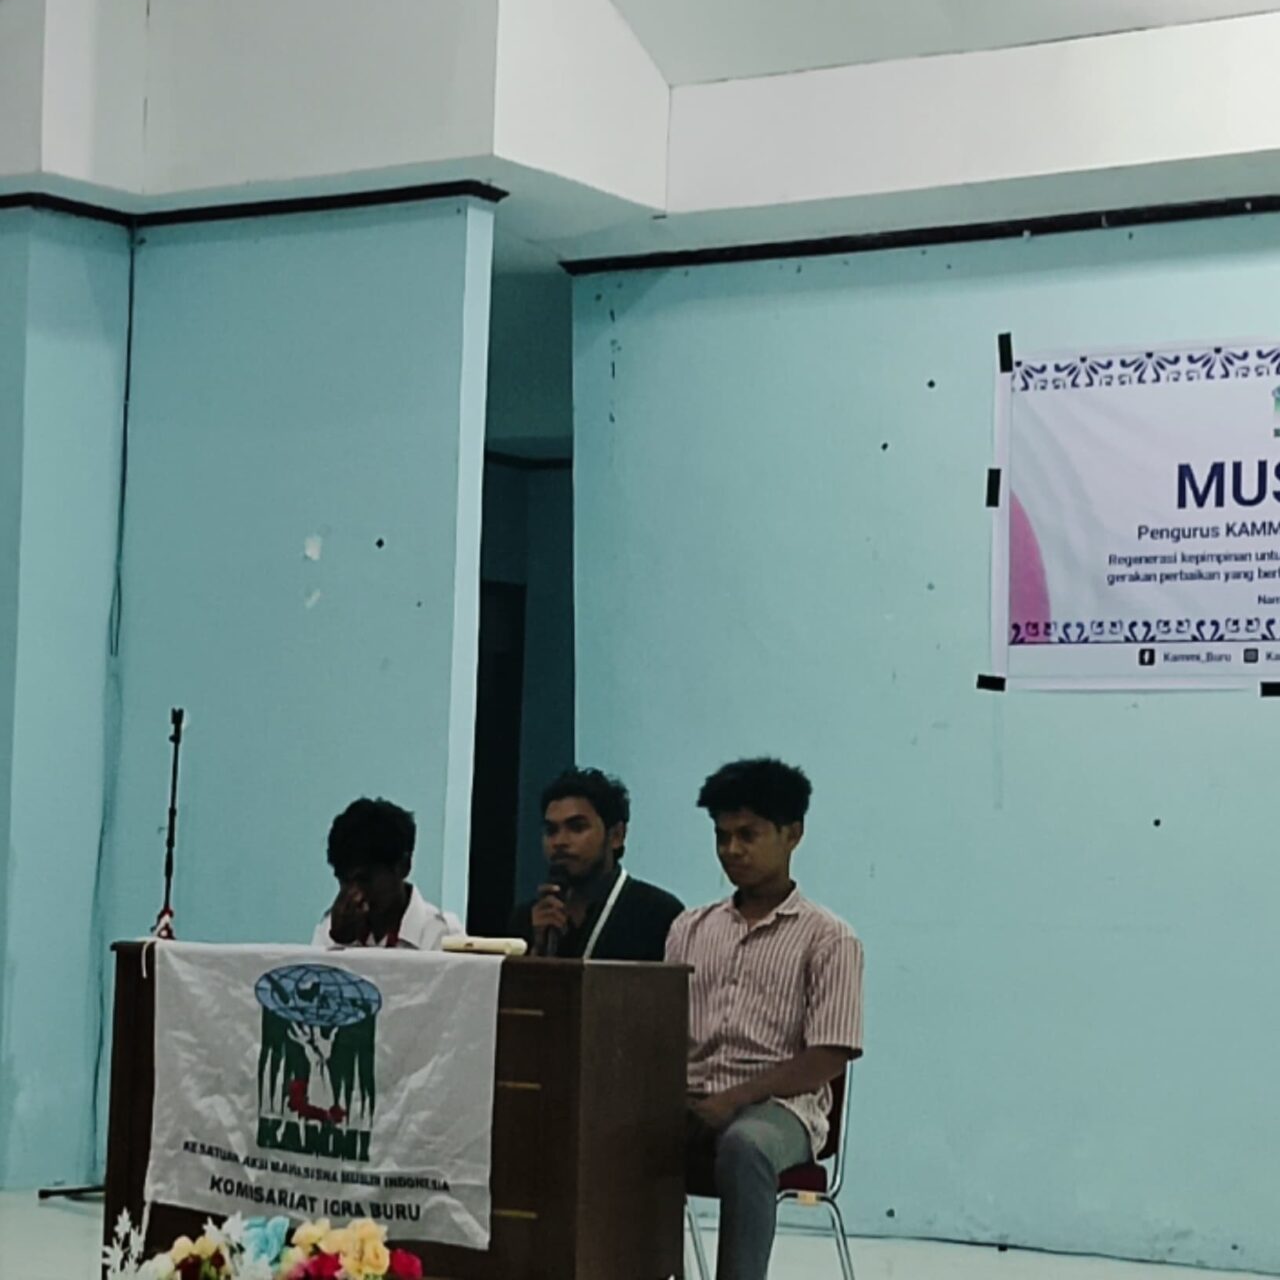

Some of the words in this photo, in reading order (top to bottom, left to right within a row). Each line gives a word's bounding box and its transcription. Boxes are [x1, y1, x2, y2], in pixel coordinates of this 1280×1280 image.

[1137, 524, 1221, 544] Pengurus
[1108, 552, 1178, 568] Regenerasi
[1181, 550, 1252, 566] kepimpinan
[1107, 570, 1157, 586] gerakan
[1159, 568, 1221, 585] perbaikan
[1224, 568, 1255, 583] yang
[210, 1175, 319, 1214] KOMISARIAT
[369, 1201, 422, 1222] BURU
